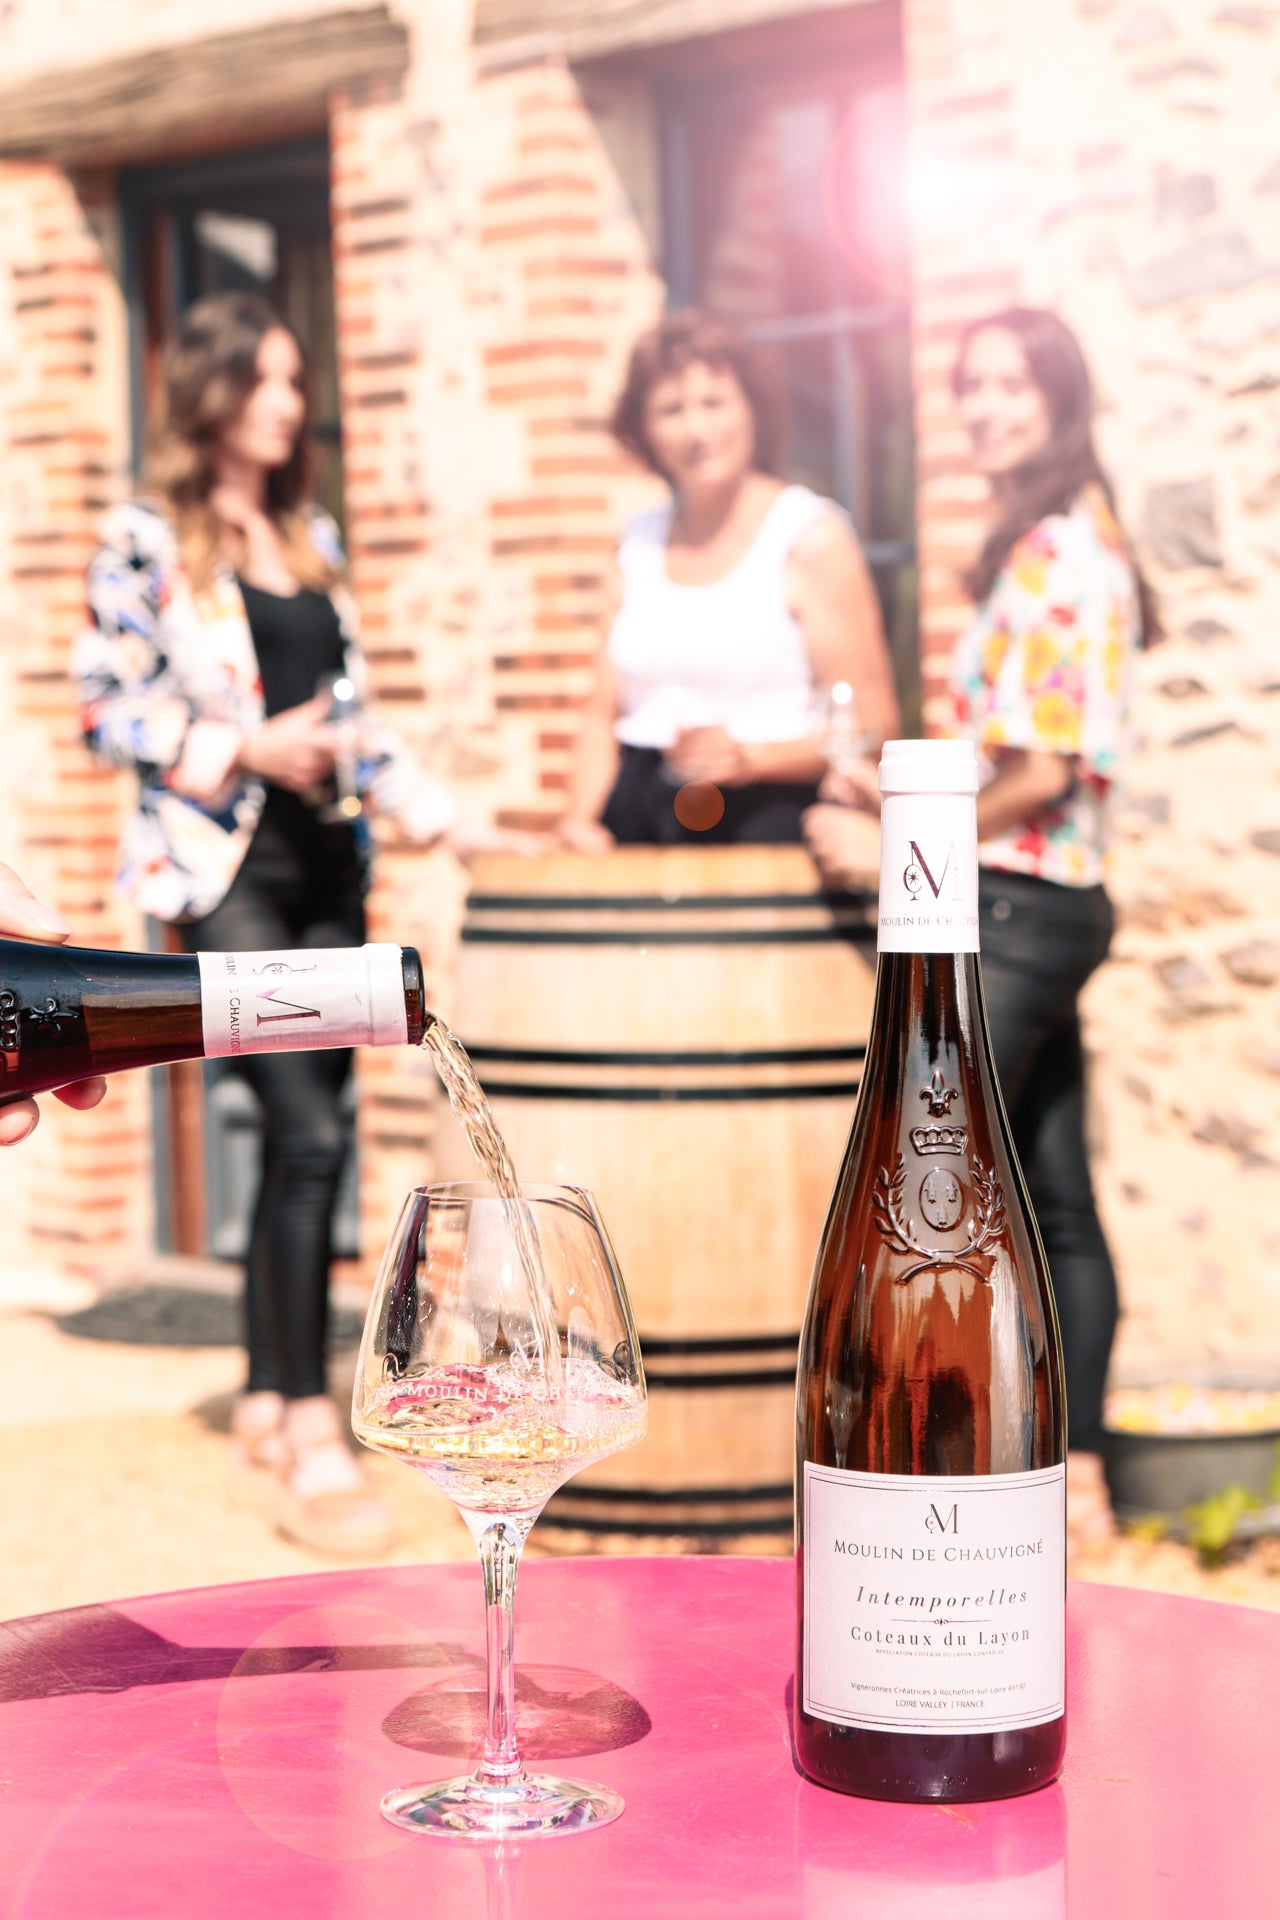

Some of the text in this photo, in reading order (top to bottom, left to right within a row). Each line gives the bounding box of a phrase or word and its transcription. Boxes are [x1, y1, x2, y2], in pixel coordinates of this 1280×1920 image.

[880, 916, 914, 926] MOULIN
[407, 1385, 489, 1402] MOULIN
[834, 1538, 1043, 1562] MOULIN DE CHAUVIGNÉ
[855, 1586, 1028, 1613] Intemporelles
[850, 1626, 1031, 1647] Coteaux du Layon
[875, 1649, 913, 1657] APPELLATION
[914, 1650, 941, 1658] COTEAUX
[953, 1650, 972, 1658] LAYON
[850, 1681, 892, 1695] Vigneronnes
[894, 1685, 931, 1697] Créatrices
[932, 1687, 938, 1696] à
[895, 1699, 986, 1709] LOIRE VALLEY FRANCE
